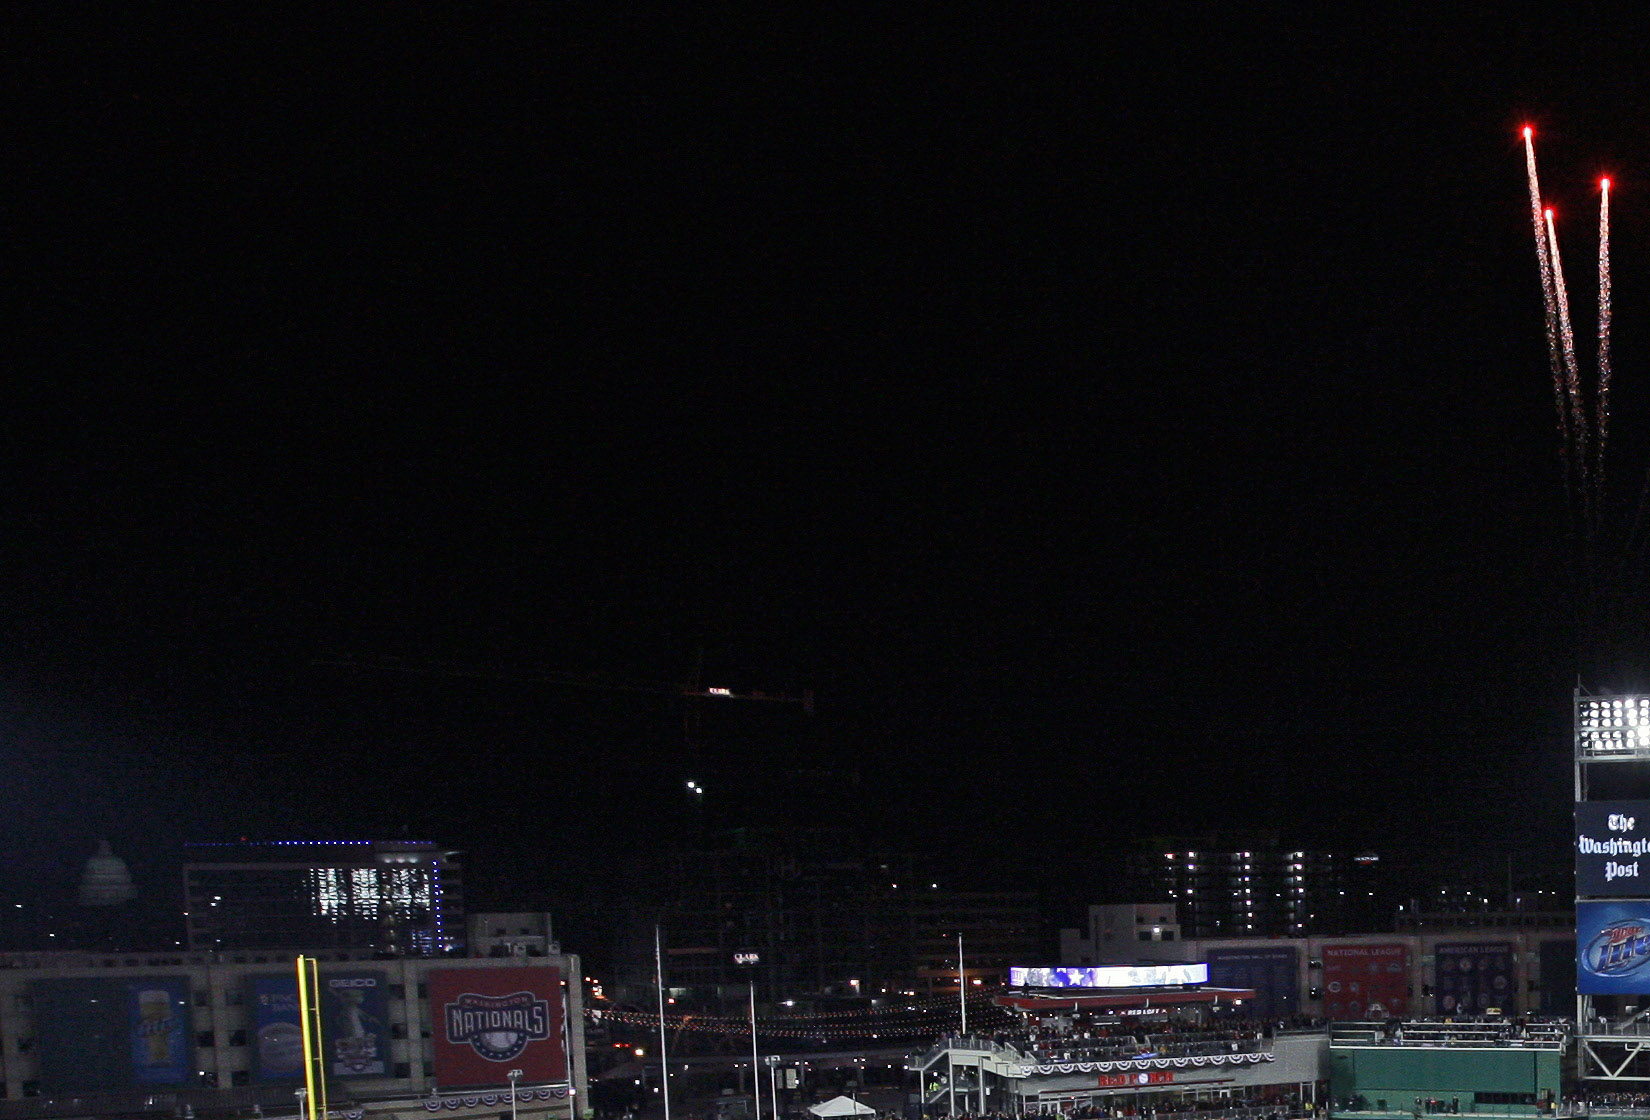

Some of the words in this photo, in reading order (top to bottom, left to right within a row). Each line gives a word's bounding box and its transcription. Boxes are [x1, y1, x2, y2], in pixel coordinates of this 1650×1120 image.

[1608, 814, 1635, 832] The
[1605, 861, 1639, 882] Post
[452, 1006, 544, 1037] NATIONALS
